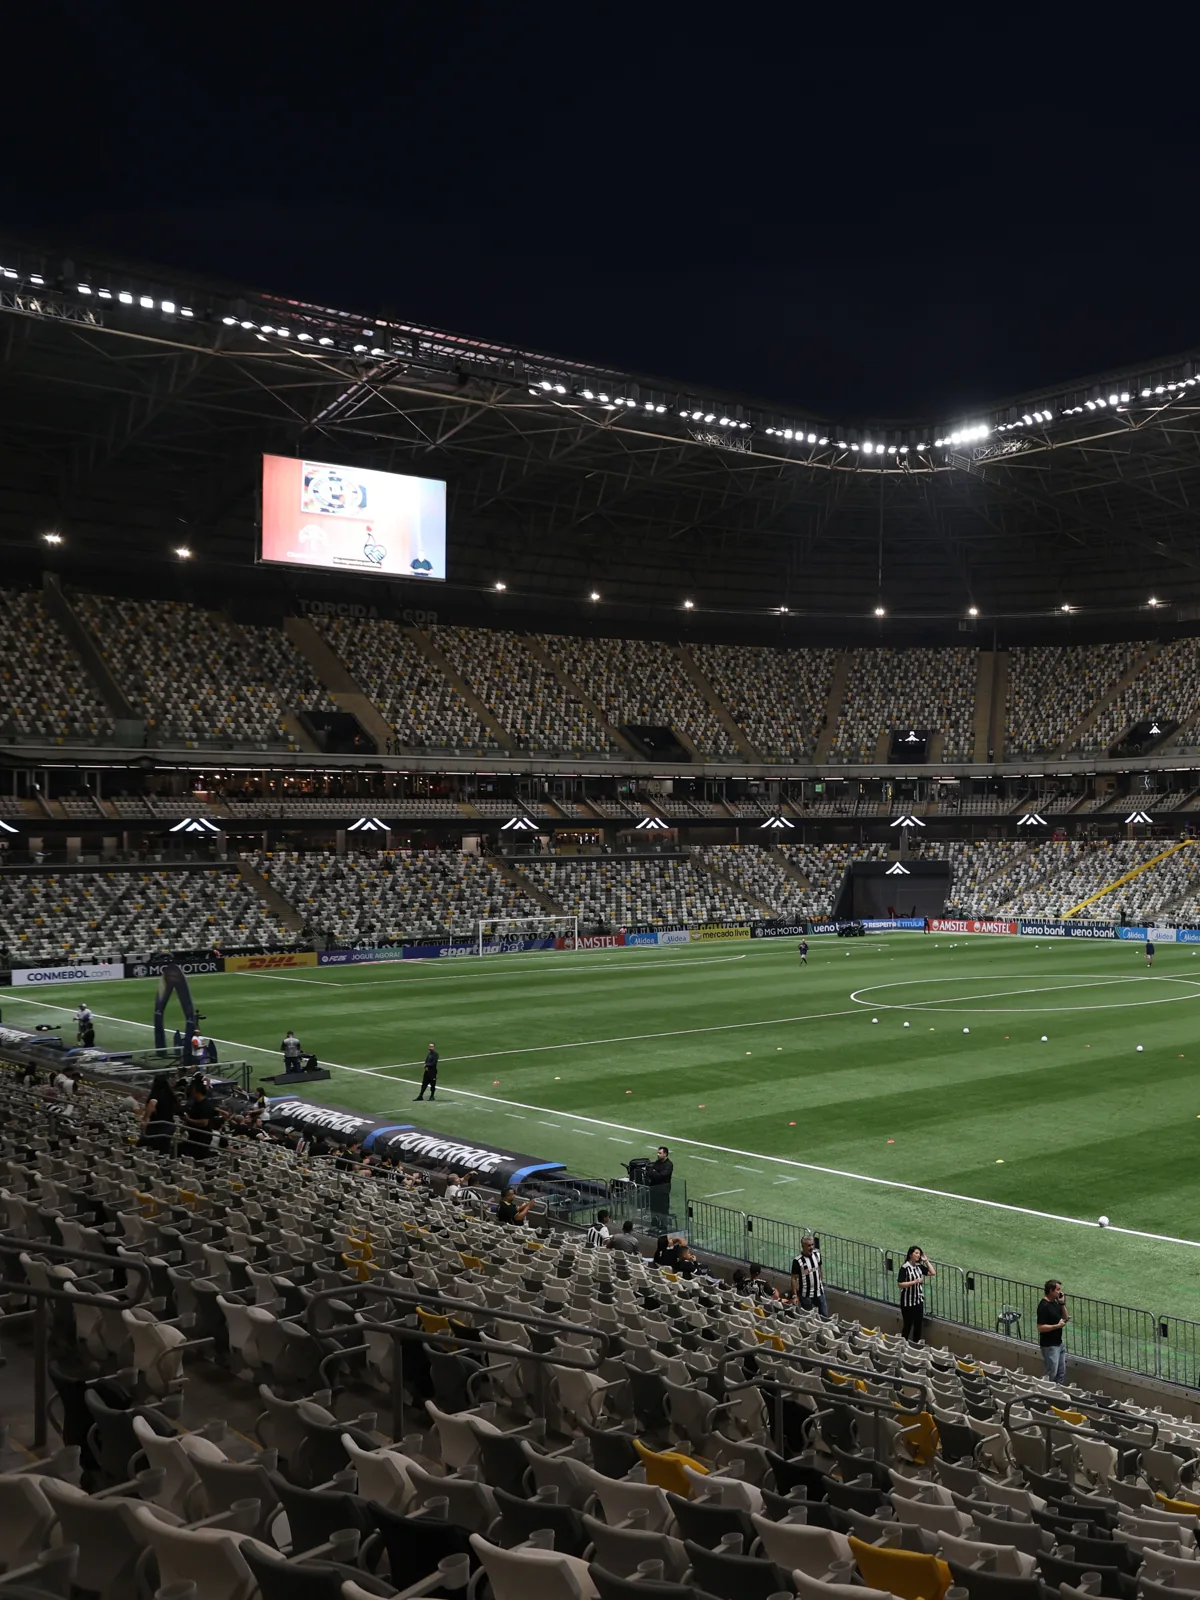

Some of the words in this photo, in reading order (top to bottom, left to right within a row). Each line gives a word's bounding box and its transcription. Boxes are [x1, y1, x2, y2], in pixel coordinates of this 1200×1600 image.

[764, 928, 776, 936] MG
[777, 926, 803, 935] MOTOR
[814, 924, 835, 933] ueno
[940, 921, 968, 931] AMSTEL
[981, 922, 1010, 933] AMSTEL
[1022, 926, 1043, 935] ueno
[1044, 925, 1065, 936] bank
[702, 928, 733, 939] mercado
[734, 926, 749, 937] livre
[1071, 928, 1093, 937] ueno
[1094, 928, 1115, 938] bank
[577, 936, 618, 949] AMSTEL
[440, 941, 524, 957] sportngbet
[351, 952, 373, 960] JOGUE
[247, 956, 297, 969] DHL
[27, 969, 111, 981] CONMEBOL.com
